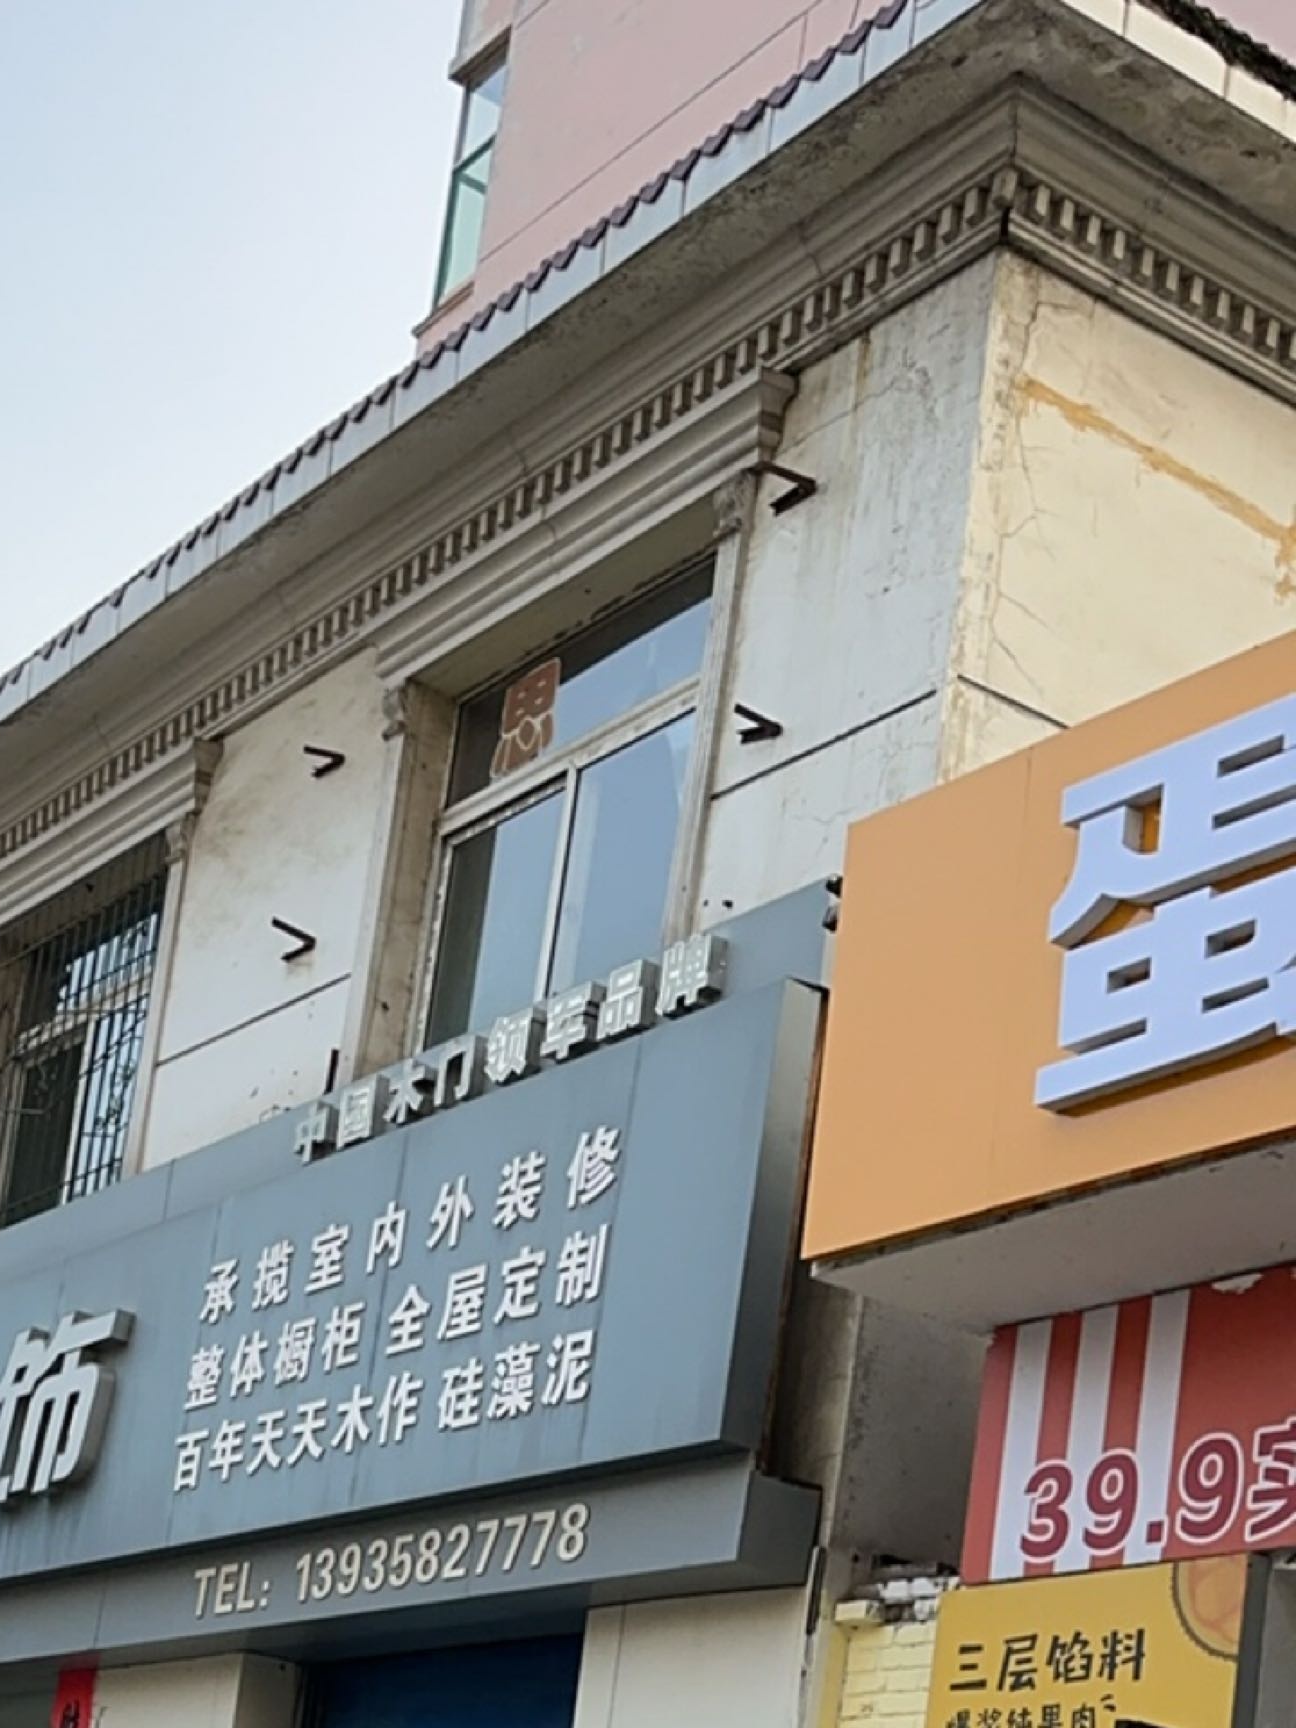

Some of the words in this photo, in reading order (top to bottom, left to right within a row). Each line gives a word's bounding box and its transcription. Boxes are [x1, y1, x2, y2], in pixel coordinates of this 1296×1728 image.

[294, 933, 727, 1163] 中国木门领军品牌
[198, 1125, 622, 1325] 承揽室内外装修
[183, 1300, 365, 1413] 整体橱柜
[384, 1224, 611, 1360] 全屋定制
[173, 1373, 425, 1493] 百年天天木作
[436, 1328, 597, 1433] 硅藻泥
[295, 1503, 591, 1604] 13935827778
[948, 1627, 1147, 1694] 三层馅料
